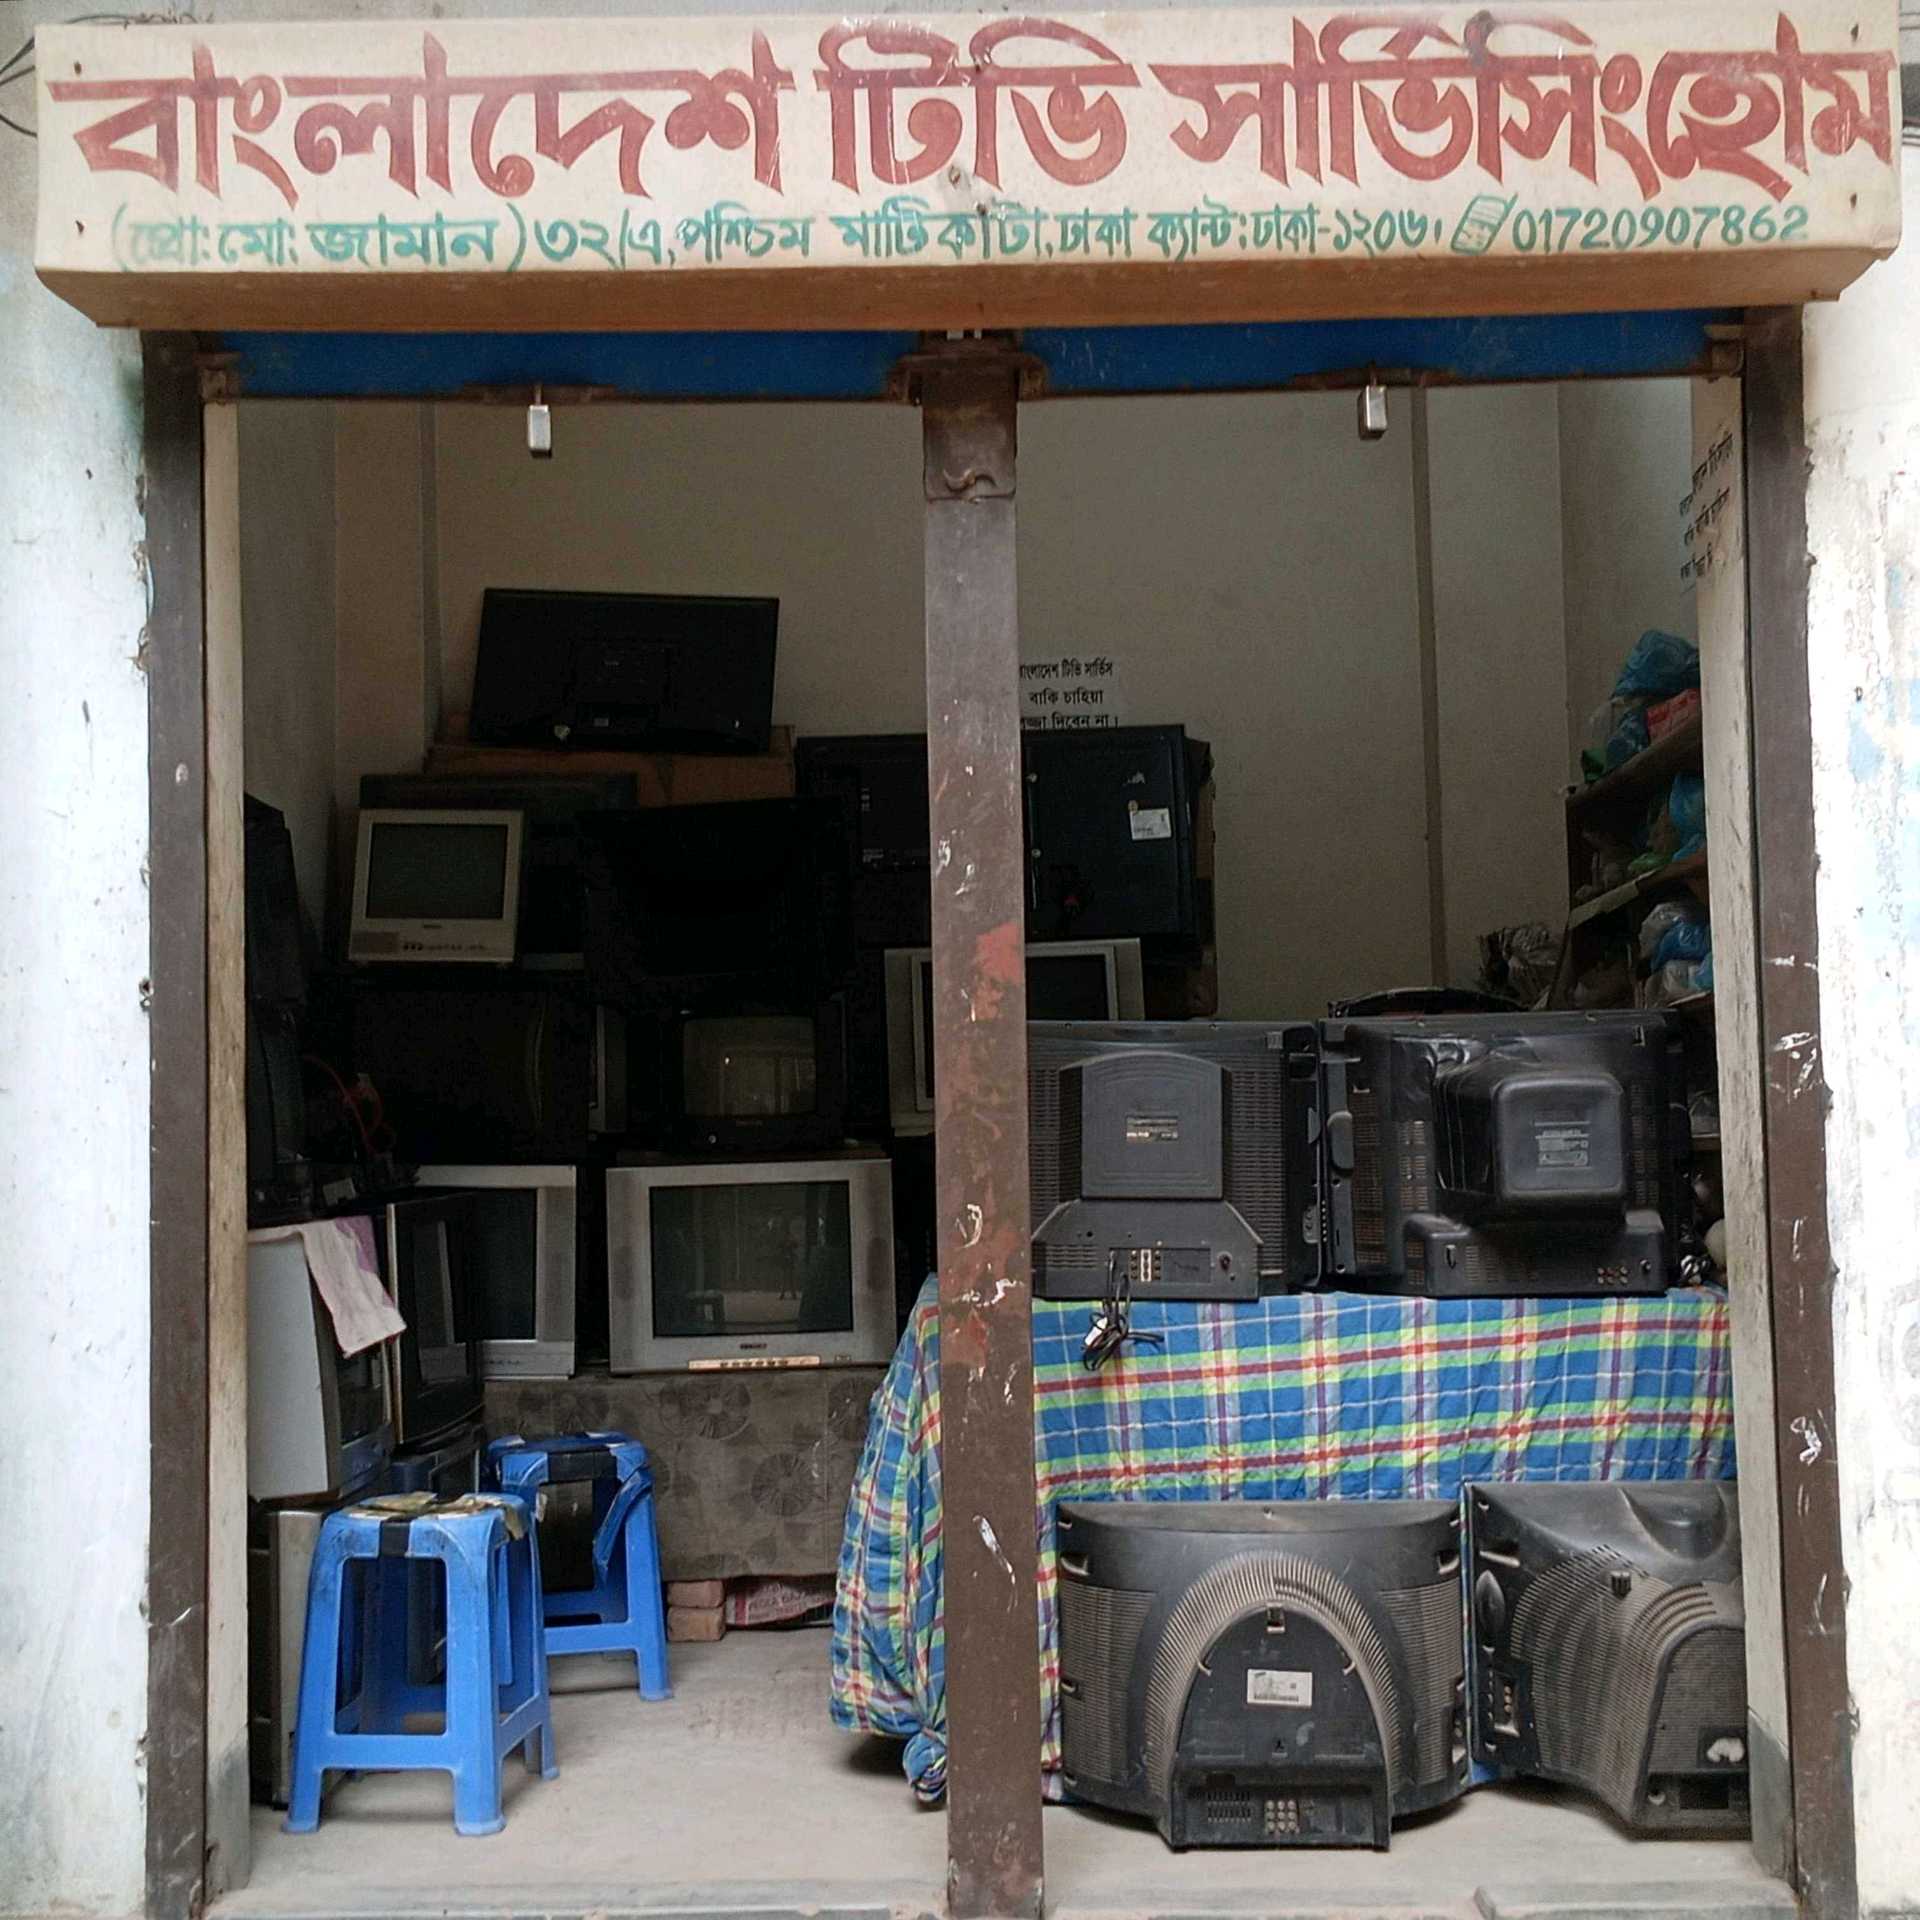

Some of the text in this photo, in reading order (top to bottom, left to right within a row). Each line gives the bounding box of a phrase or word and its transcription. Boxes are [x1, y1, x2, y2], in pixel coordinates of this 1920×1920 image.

[47, 30, 795, 209] বাংলাদেশ
[812, 17, 1142, 194] টিভি
[1511, 204, 1809, 255] 01720907862
